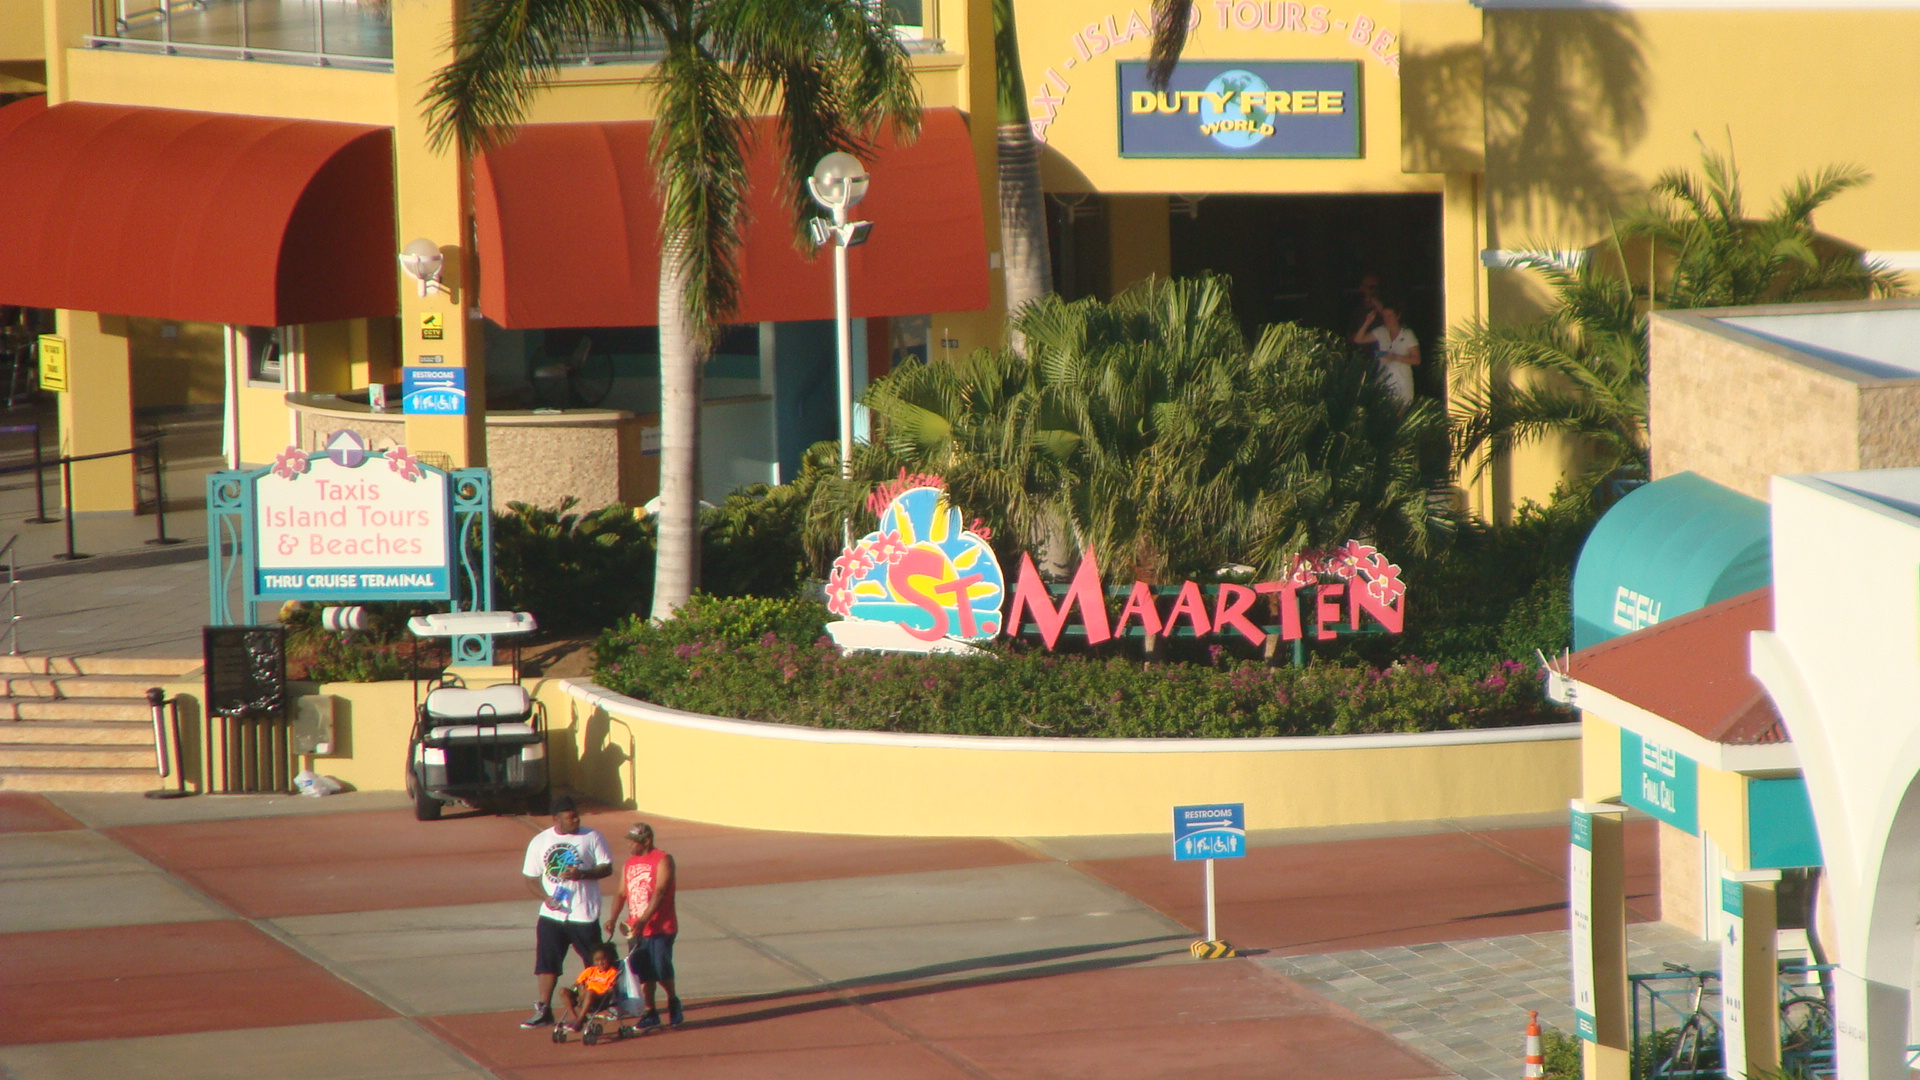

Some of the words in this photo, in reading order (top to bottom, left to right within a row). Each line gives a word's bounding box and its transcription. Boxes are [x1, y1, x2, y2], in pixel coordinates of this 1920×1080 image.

[1030, 67, 1070, 143] AXI
[1214, 0, 1330, 35] TOURS
[1131, 90, 1236, 115] DUTY
[1240, 90, 1344, 114] FREE
[1199, 119, 1276, 136] WORLD
[412, 371, 454, 379] RESTROOMS
[315, 478, 380, 501] Taxis
[266, 505, 347, 527] Island
[356, 505, 430, 527] Tours
[969, 517, 992, 540] to
[277, 533, 299, 556] &
[310, 533, 422, 555] Beaches
[264, 575, 303, 588] THRU
[306, 574, 358, 588] CRUISE
[360, 573, 434, 587] TERMINAL
[888, 547, 997, 642] ST.
[1006, 543, 1404, 651] MAARTEN
[1185, 808, 1233, 819] RESTROOMS
